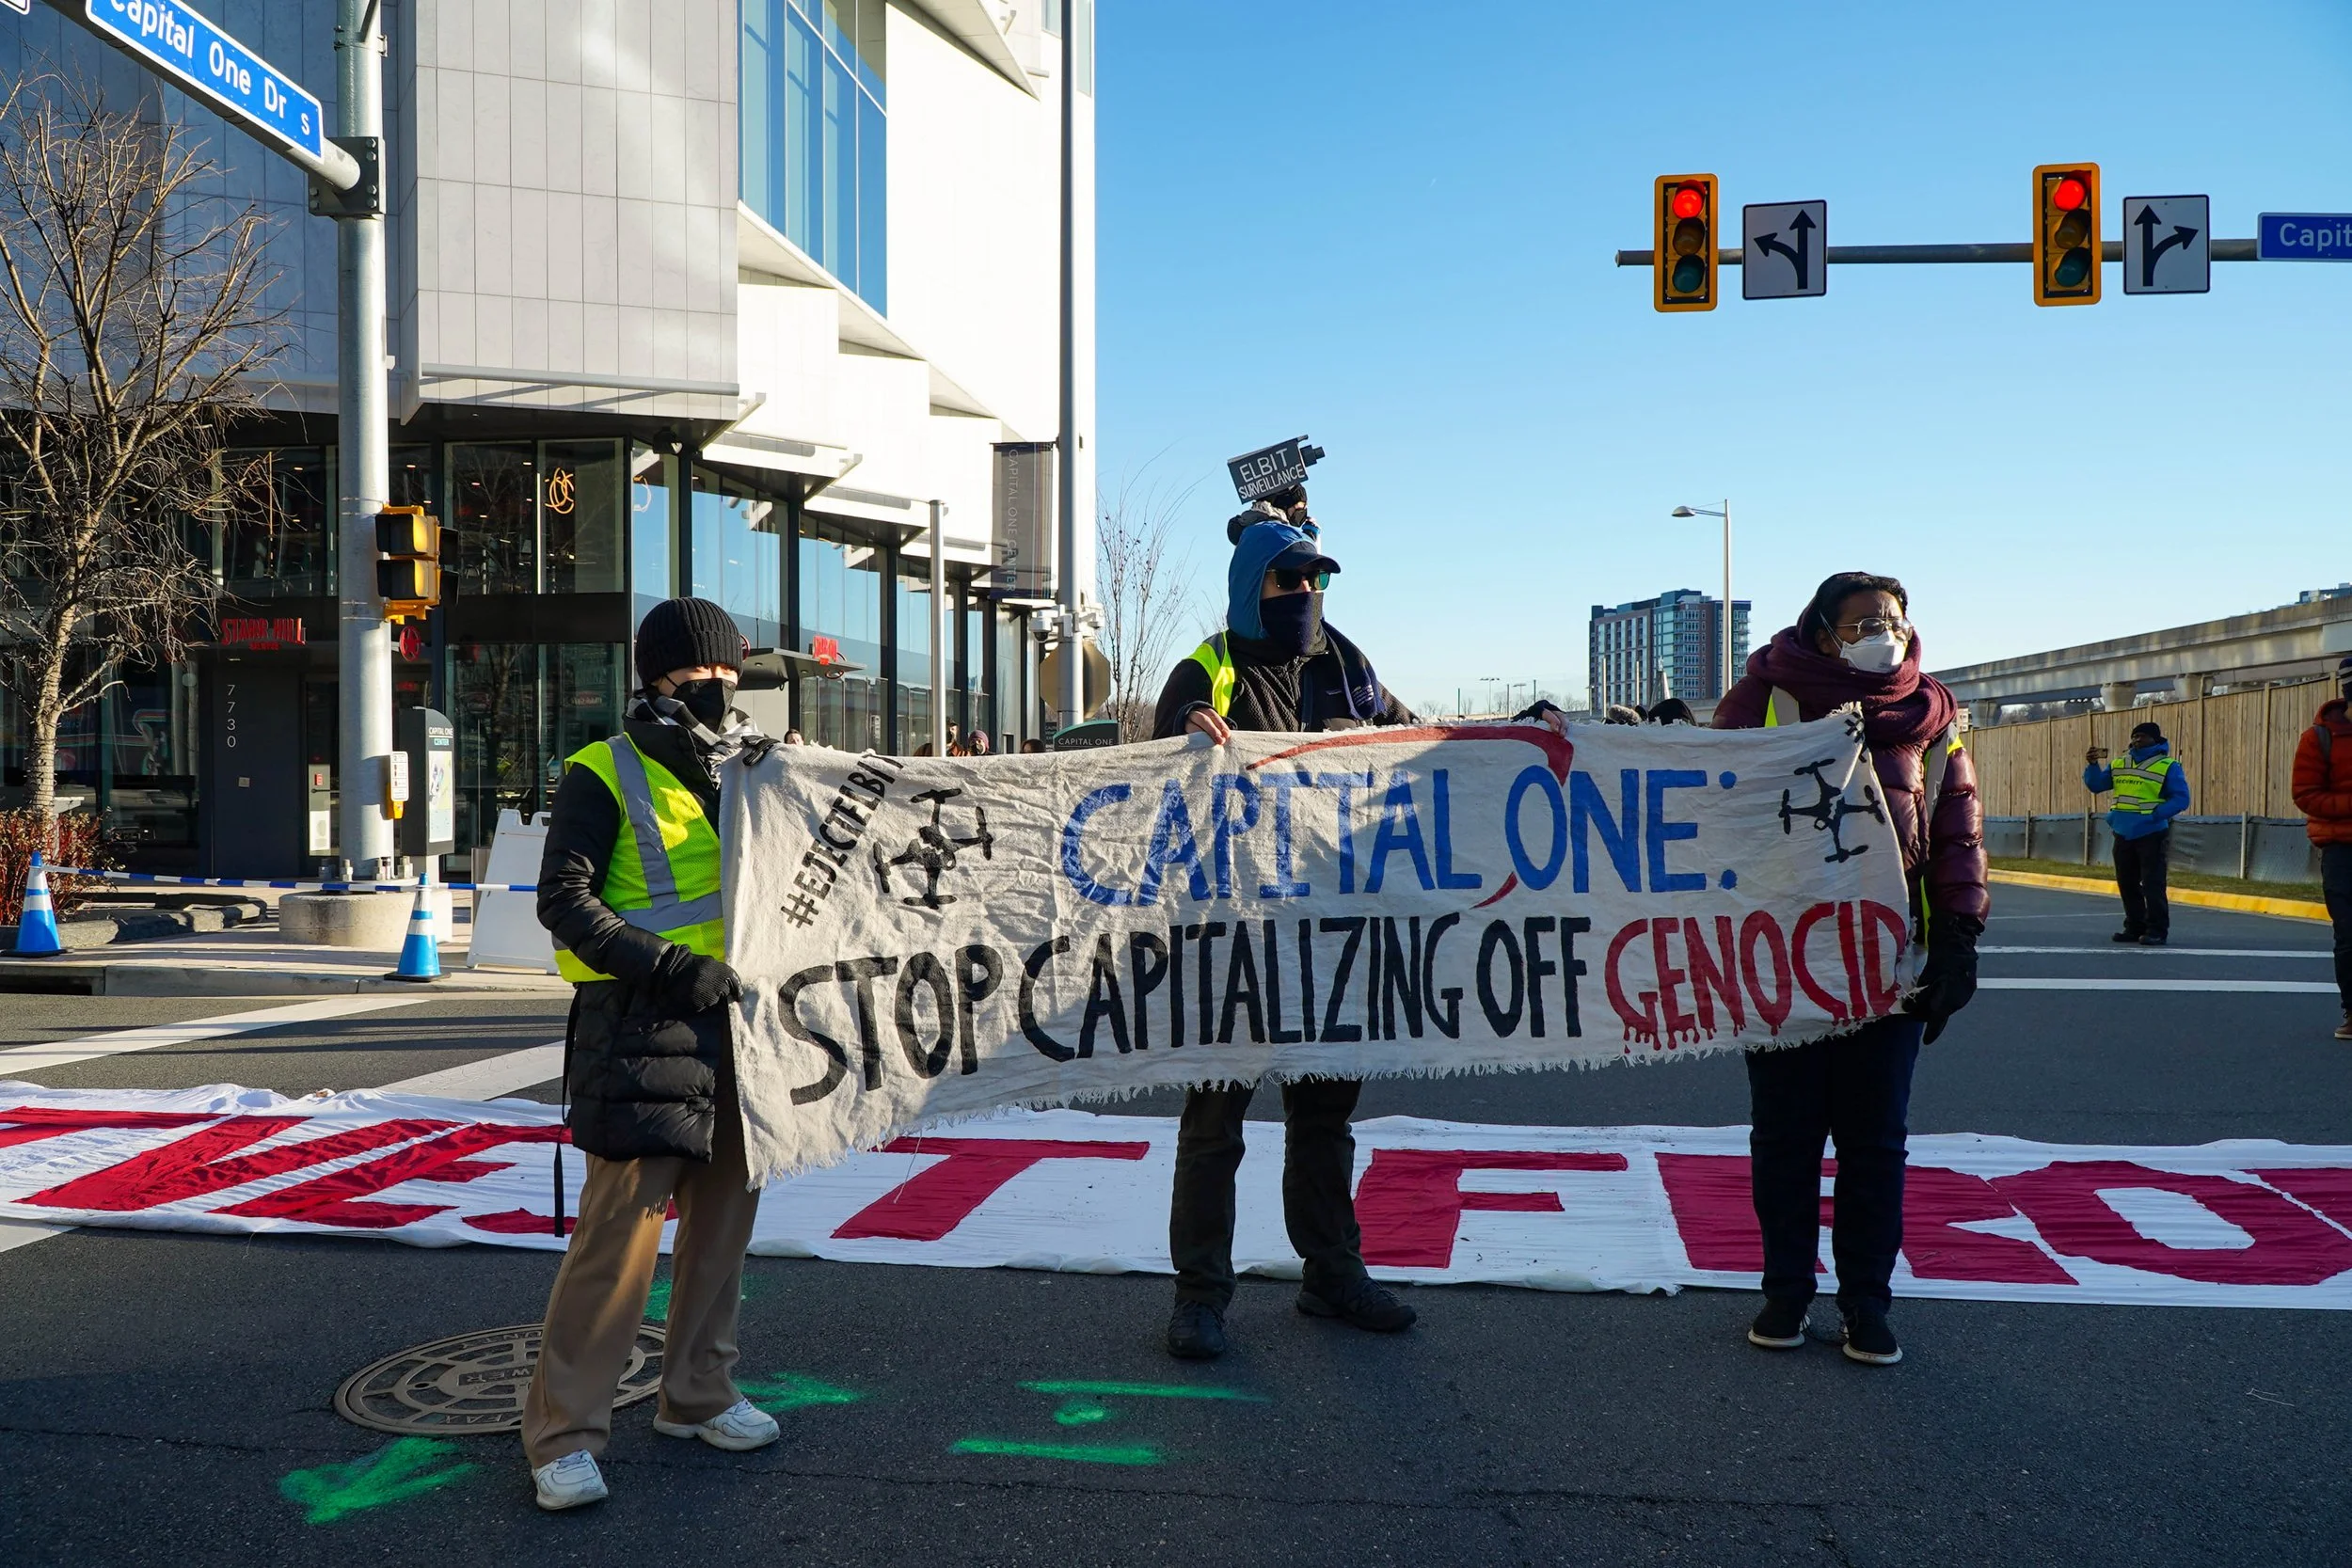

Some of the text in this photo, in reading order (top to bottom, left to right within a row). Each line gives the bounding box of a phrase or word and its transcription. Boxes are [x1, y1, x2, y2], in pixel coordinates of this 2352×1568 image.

[209, 40, 251, 95] One
[264, 77, 287, 119] Dr
[2280, 222, 2352, 252] Capit
[1238, 464, 1305, 499] SURVEILLANCE
[1239, 448, 1288, 483] ELBIT
[1006, 449, 1019, 592] CAPITAL ONE CENTER
[227, 684, 236, 748] 7730
[1058, 737, 1092, 746] CAPITAL
[1061, 765, 1738, 907] CAPITAL ONE:
[777, 900, 1907, 1106] STOP CAPITALIZING OFF GENOCID
[467, 1366, 531, 1384] WER
